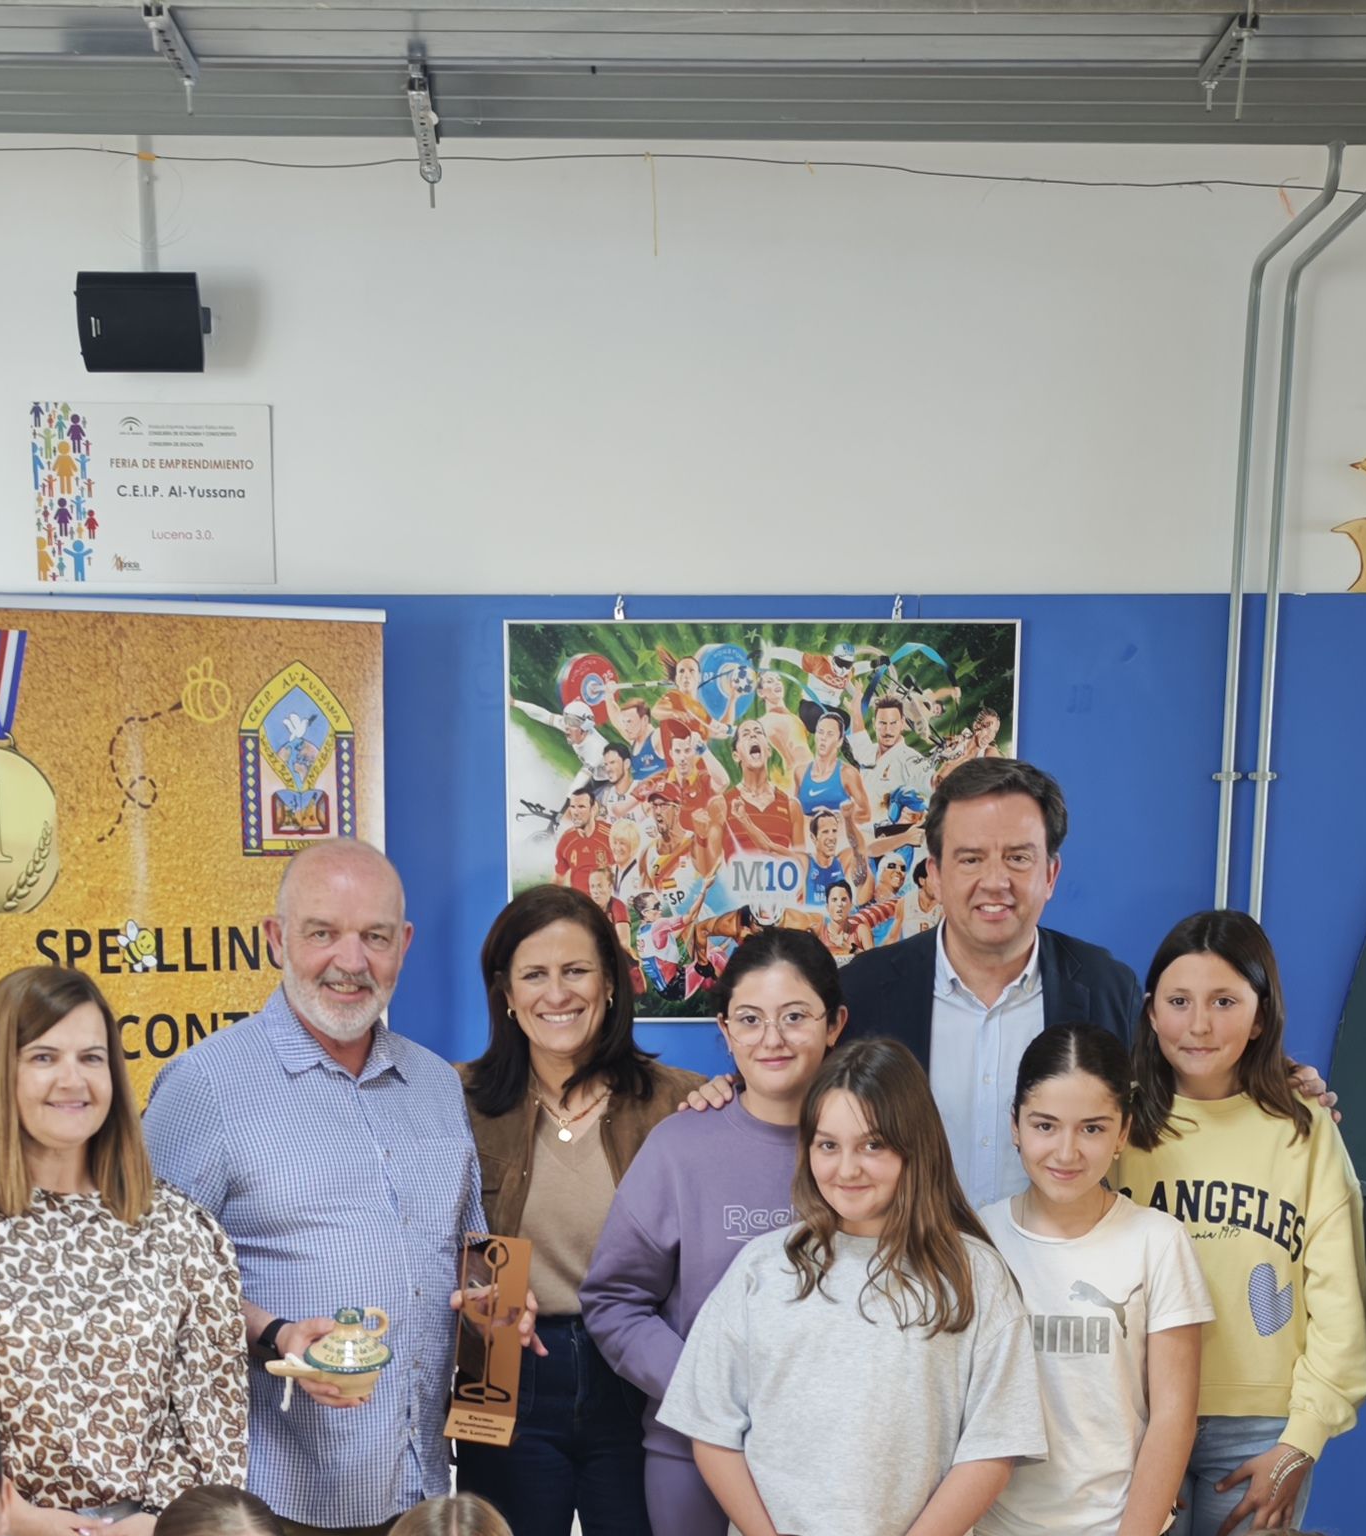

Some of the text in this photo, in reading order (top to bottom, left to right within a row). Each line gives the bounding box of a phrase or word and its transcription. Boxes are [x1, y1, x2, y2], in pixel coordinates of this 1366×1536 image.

[109, 458, 255, 471] FERIA DE EMPRENDIMIENTO
[116, 484, 246, 499] C.E.I.P. Al-Yussana
[151, 529, 193, 540] Lucena
[732, 860, 799, 892] M10
[1149, 1179, 1305, 1263] ANGELES
